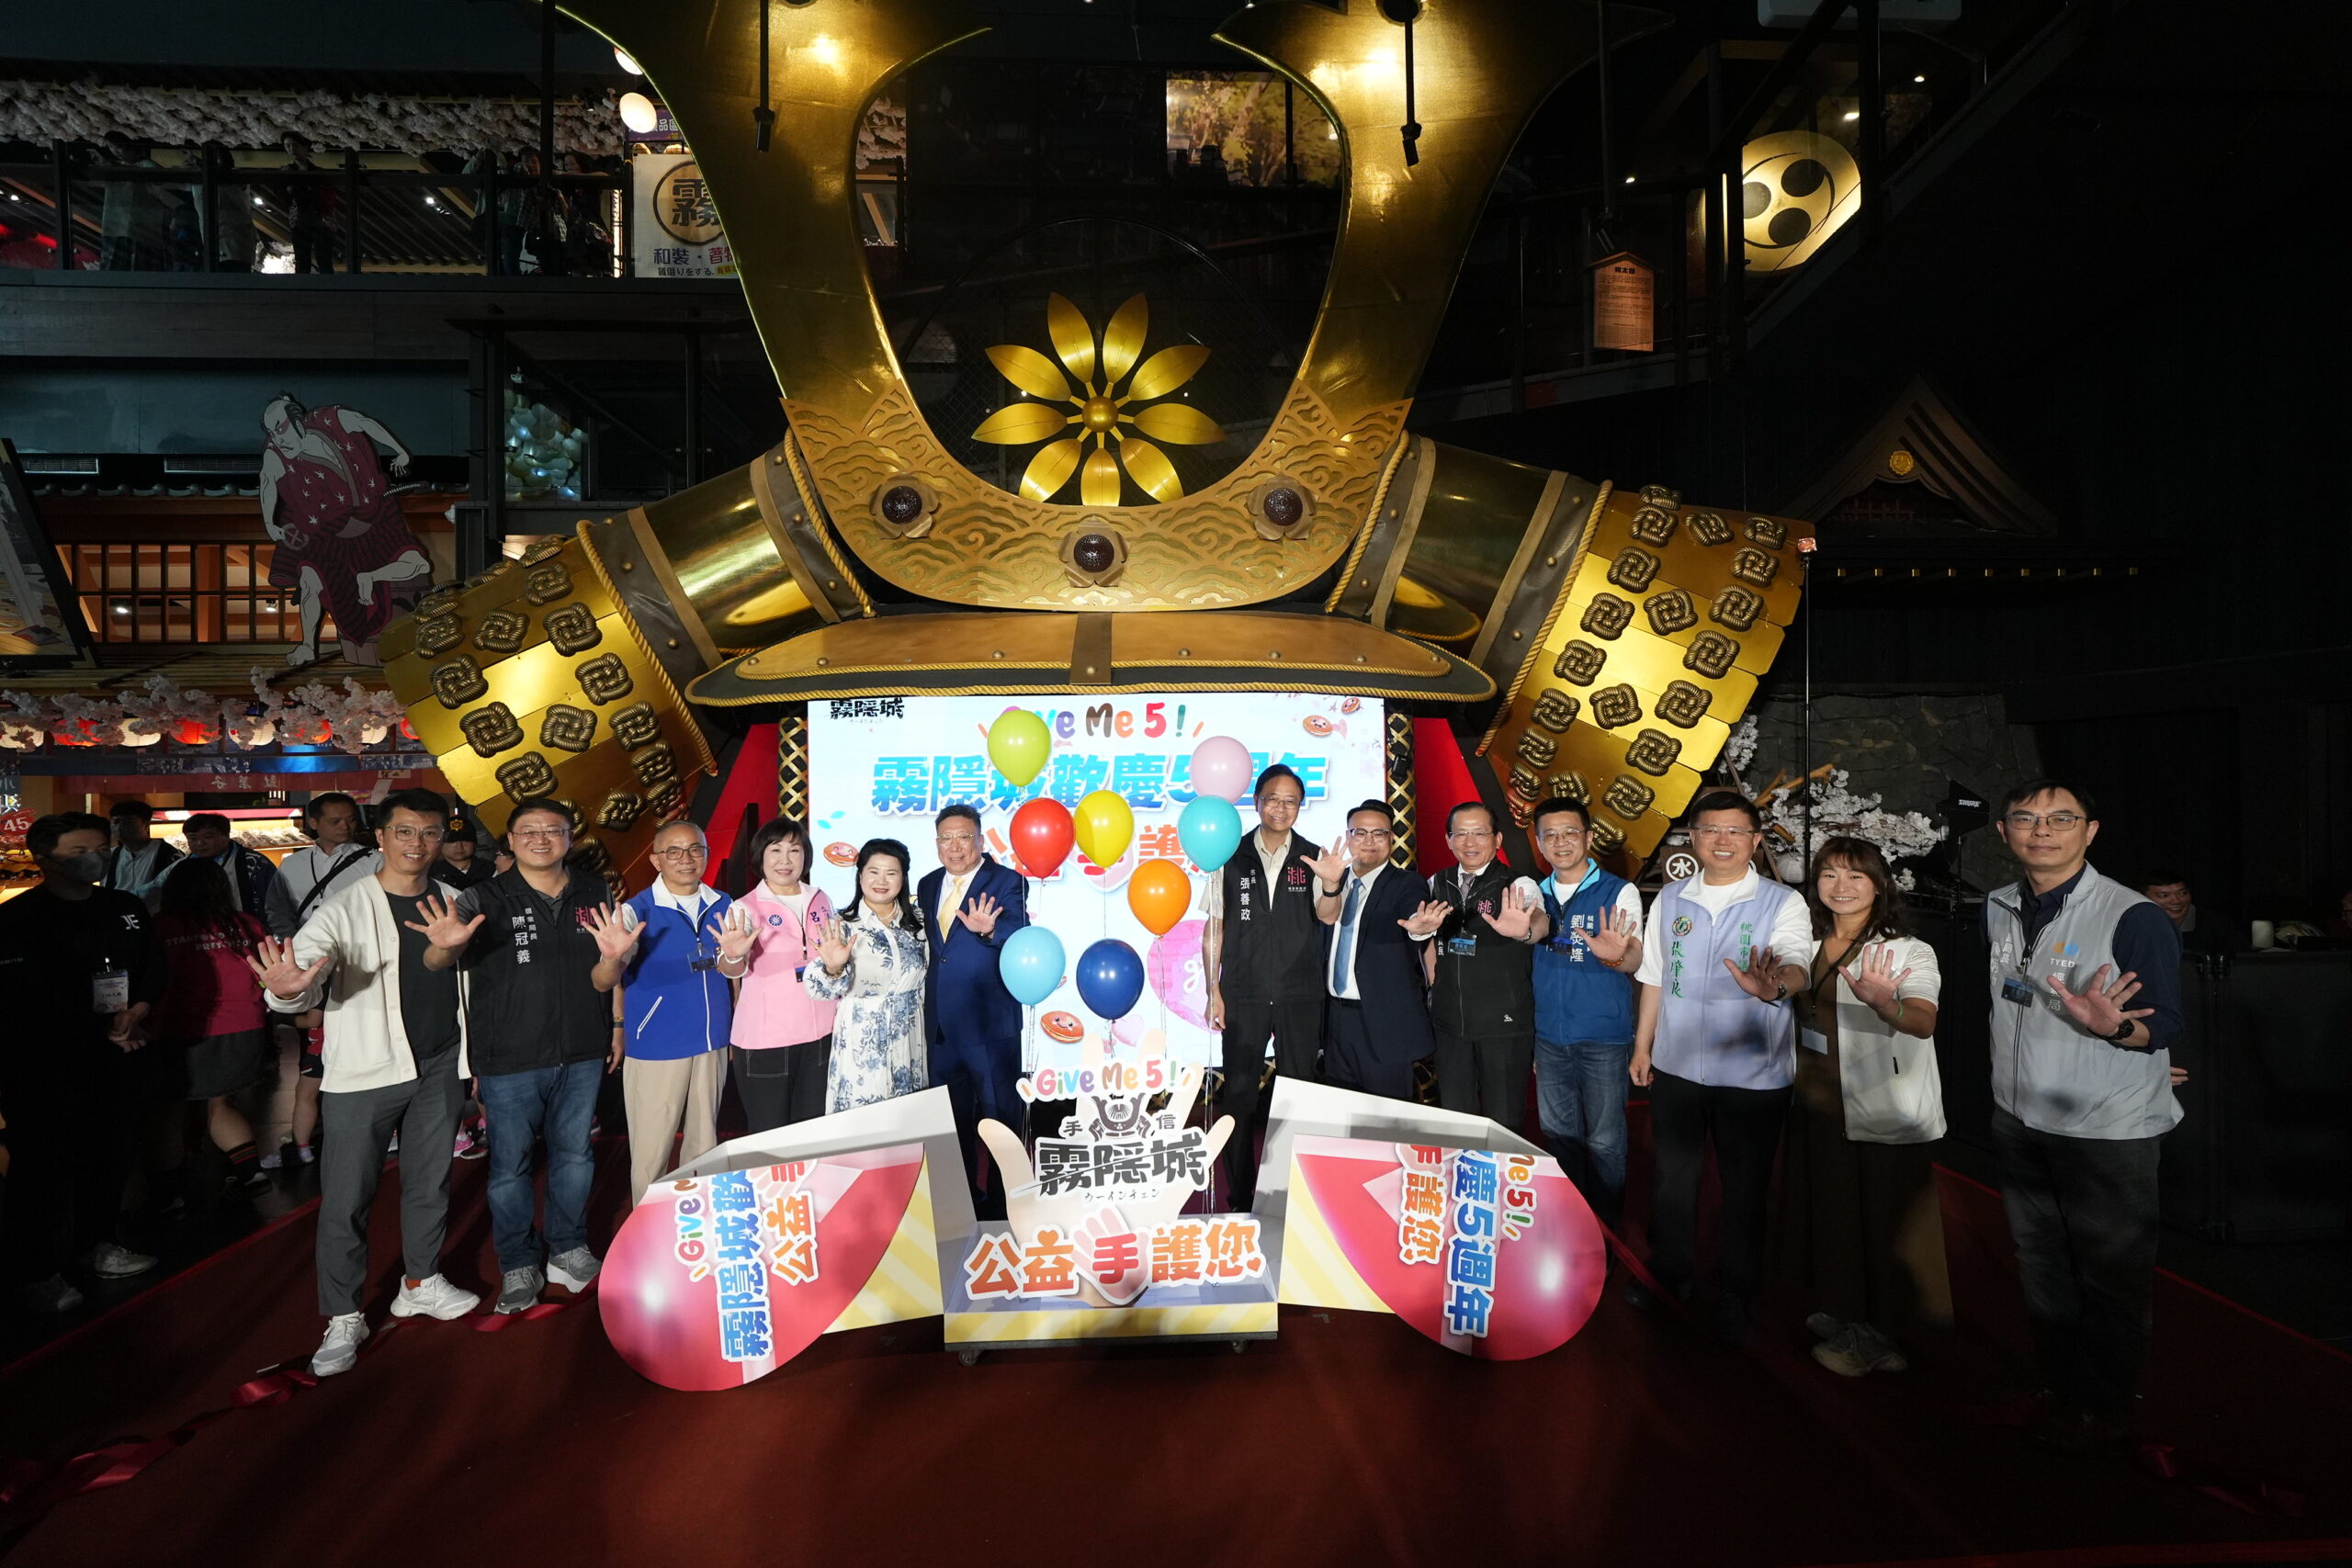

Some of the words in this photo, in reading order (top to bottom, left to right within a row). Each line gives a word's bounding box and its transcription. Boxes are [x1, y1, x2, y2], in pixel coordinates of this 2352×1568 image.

[1086, 702, 1135, 739] Me
[1958, 799, 1982, 807] SHURE
[4, 817, 29, 832] 45
[1671, 858, 1692, 878] 水
[1240, 877, 1250, 921] 張善政
[512, 915, 531, 964] 陳冠義
[2050, 958, 2075, 968] TYED
[1036, 1069, 1095, 1097] Give
[1102, 1062, 1138, 1091] Me
[968, 1222, 1259, 1295] 公益手護您
[1447, 1149, 1498, 1334] 慶5週年
